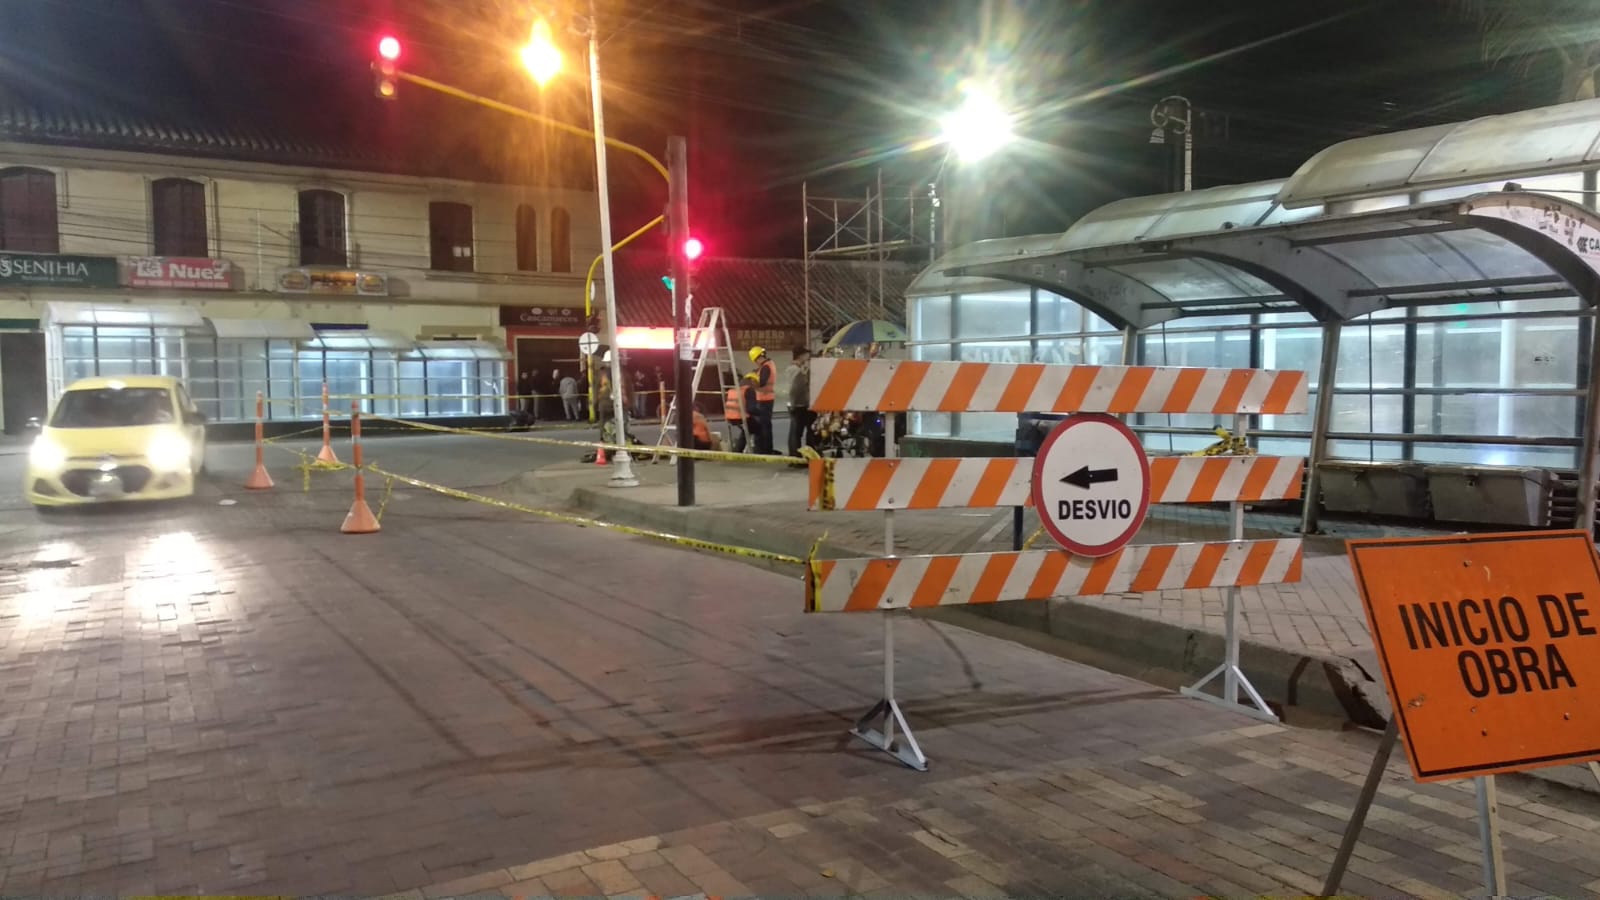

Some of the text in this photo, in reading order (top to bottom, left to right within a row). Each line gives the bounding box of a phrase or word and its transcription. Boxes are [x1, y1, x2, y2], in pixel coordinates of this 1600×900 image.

[13, 259, 89, 276] SENTHIA
[168, 263, 225, 280] Nuez
[1058, 499, 1131, 520] DESVIO
[1398, 592, 1597, 650] INICIO DE
[1457, 643, 1577, 699] OBRA
